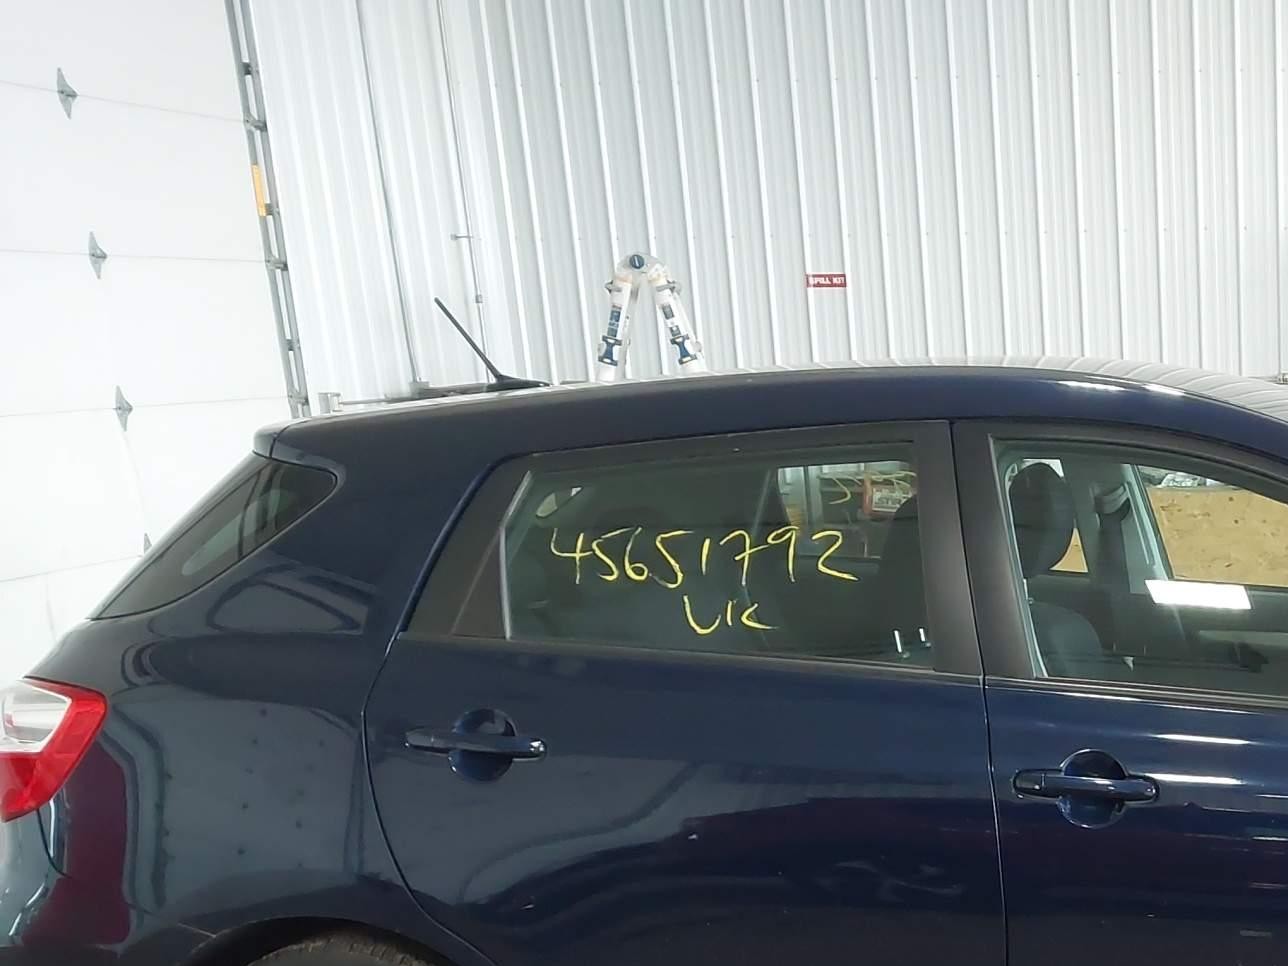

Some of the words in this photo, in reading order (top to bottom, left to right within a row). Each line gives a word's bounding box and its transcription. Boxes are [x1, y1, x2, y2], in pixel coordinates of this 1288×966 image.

[808, 276, 831, 285] SPILL
[833, 276, 845, 284] KIT
[550, 525, 859, 588] 45651792
